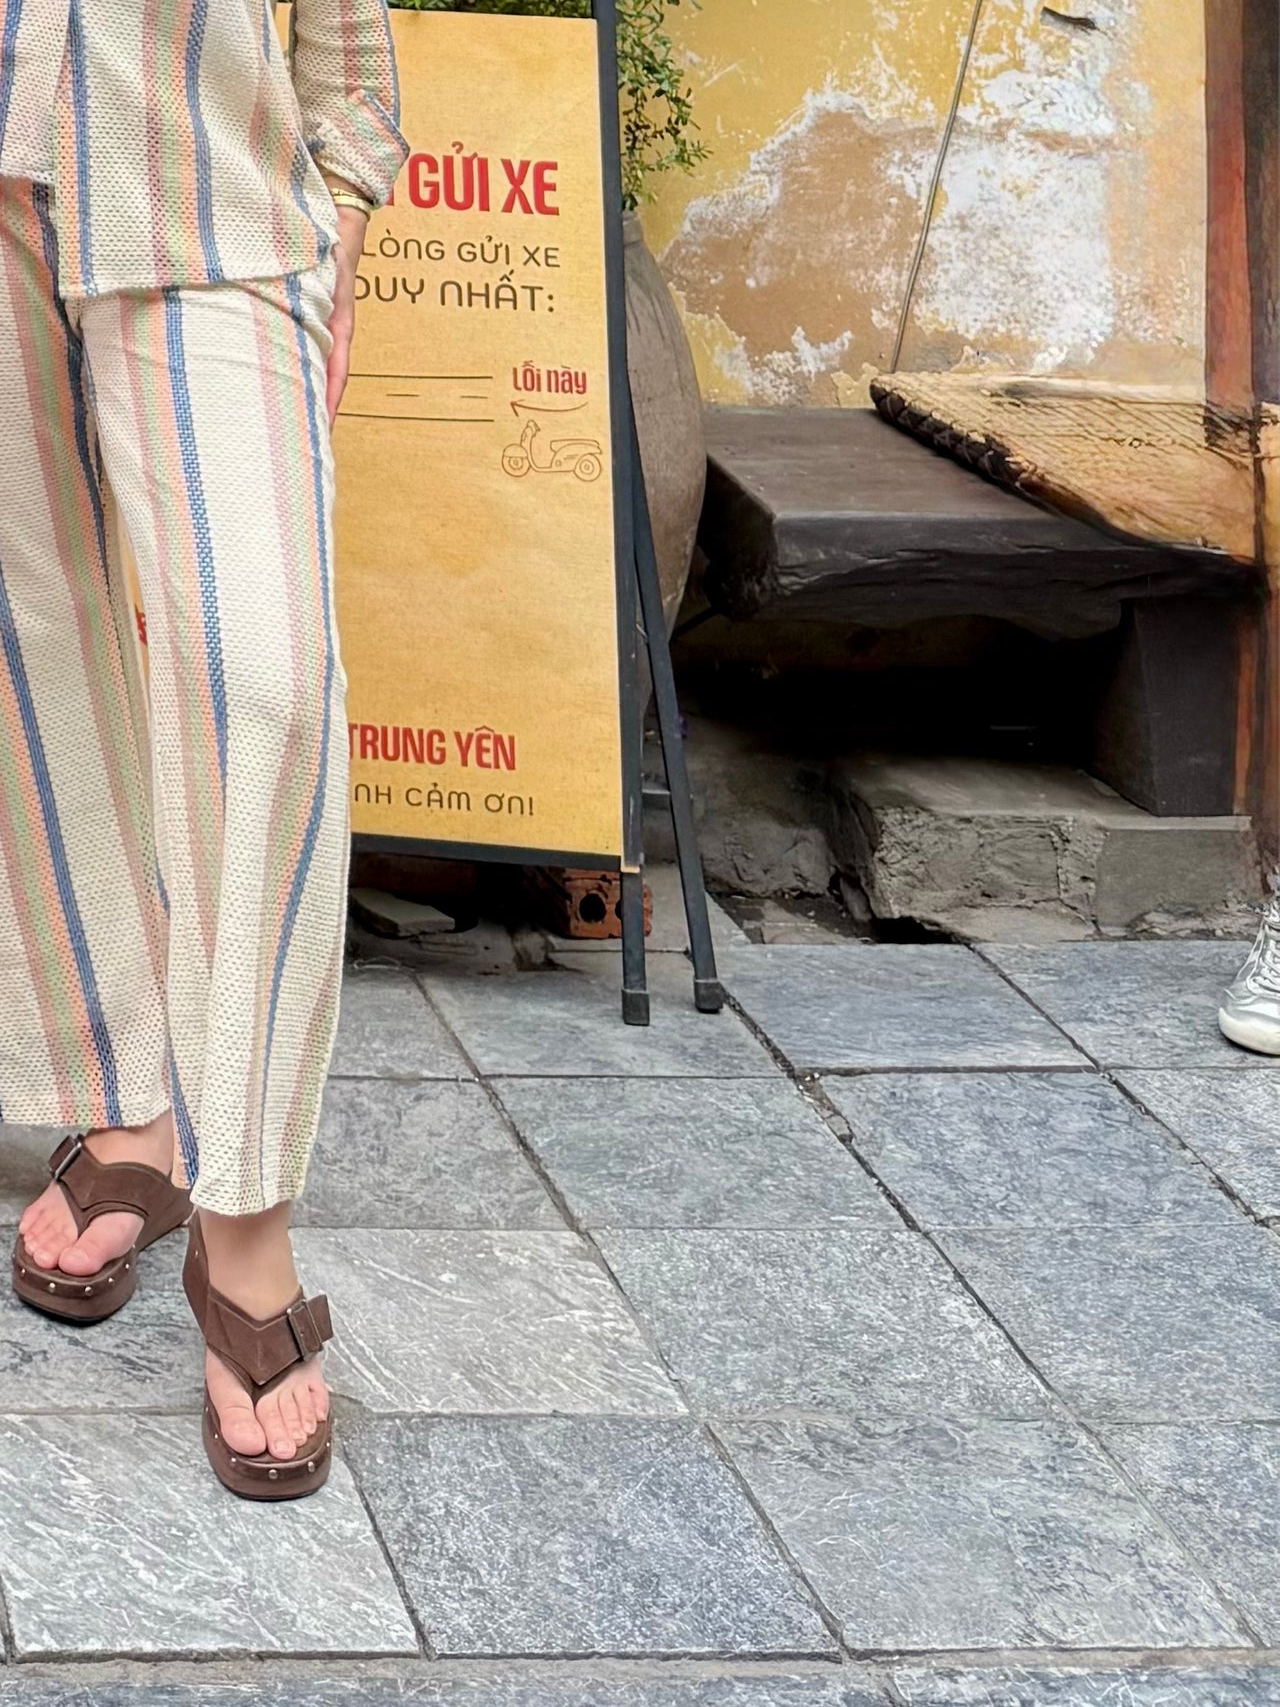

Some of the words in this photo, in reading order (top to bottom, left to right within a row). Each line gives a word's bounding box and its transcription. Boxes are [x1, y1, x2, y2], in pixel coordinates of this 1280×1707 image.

[408, 141, 490, 213] GỬI
[501, 158, 560, 216] XE
[361, 228, 445, 261] LÒNG
[457, 235, 510, 265] GỬI
[522, 245, 561, 268] XE
[440, 269, 554, 313] NHẤT:
[547, 365, 588, 395] này
[348, 722, 447, 766] TRUNG
[454, 725, 516, 771] YÊN
[405, 782, 472, 812] CẢM
[484, 793, 535, 817] ƠN!
